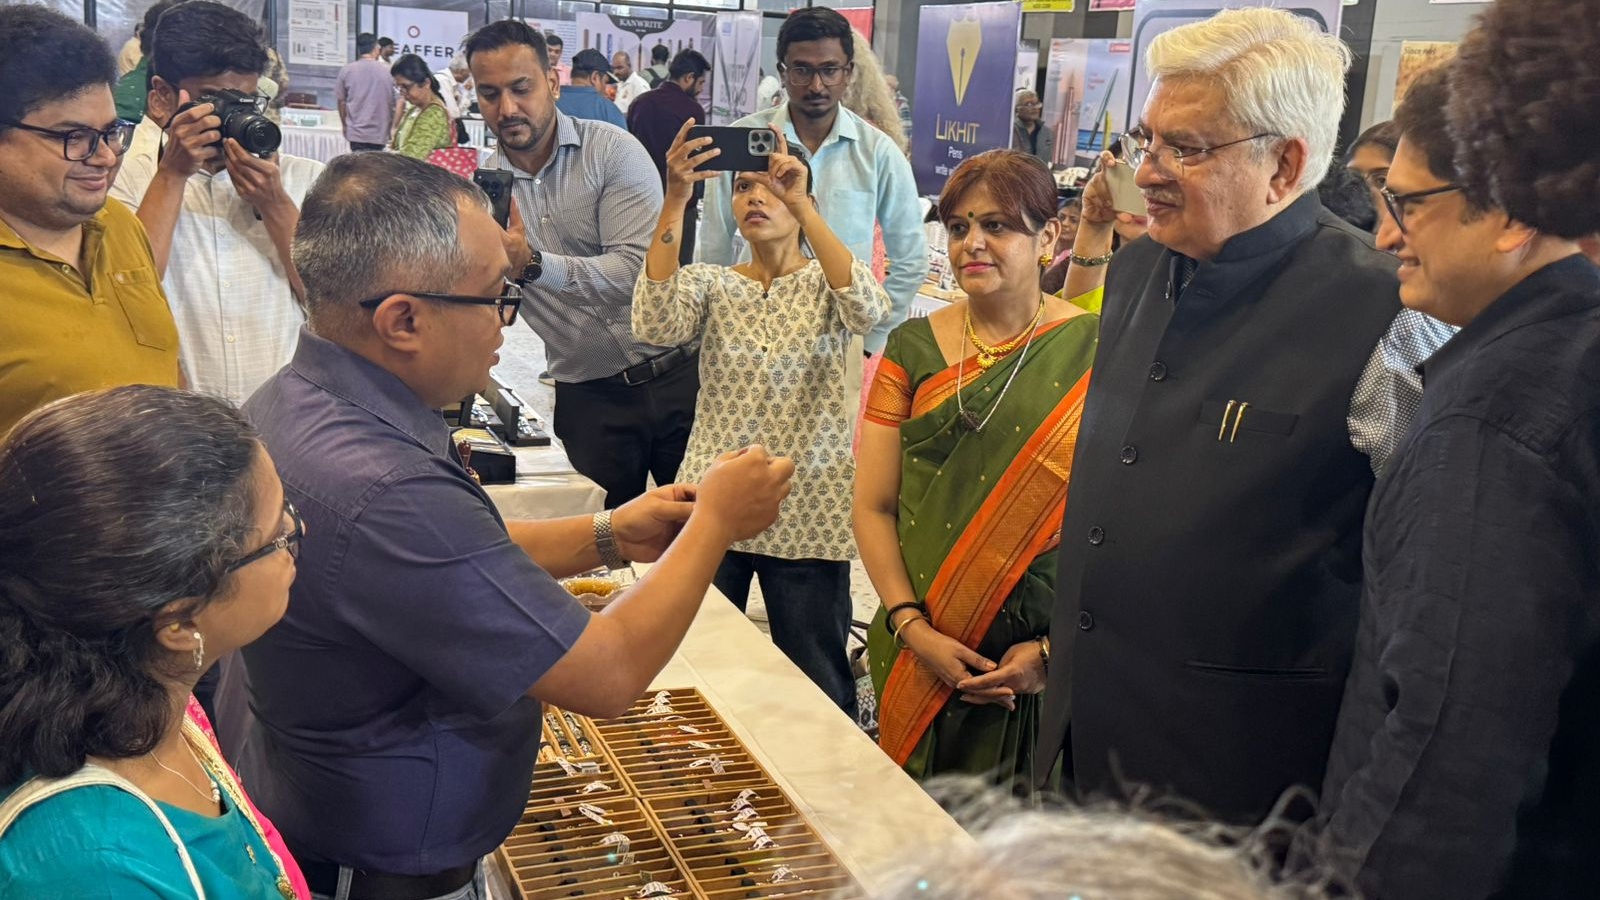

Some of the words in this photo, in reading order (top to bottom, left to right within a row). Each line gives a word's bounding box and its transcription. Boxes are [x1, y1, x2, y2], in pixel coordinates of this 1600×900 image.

[619, 18, 663, 29] KANWRITE
[392, 43, 455, 58] EAFFER
[935, 112, 980, 144] LIKHIT
[948, 146, 963, 159] Pens
